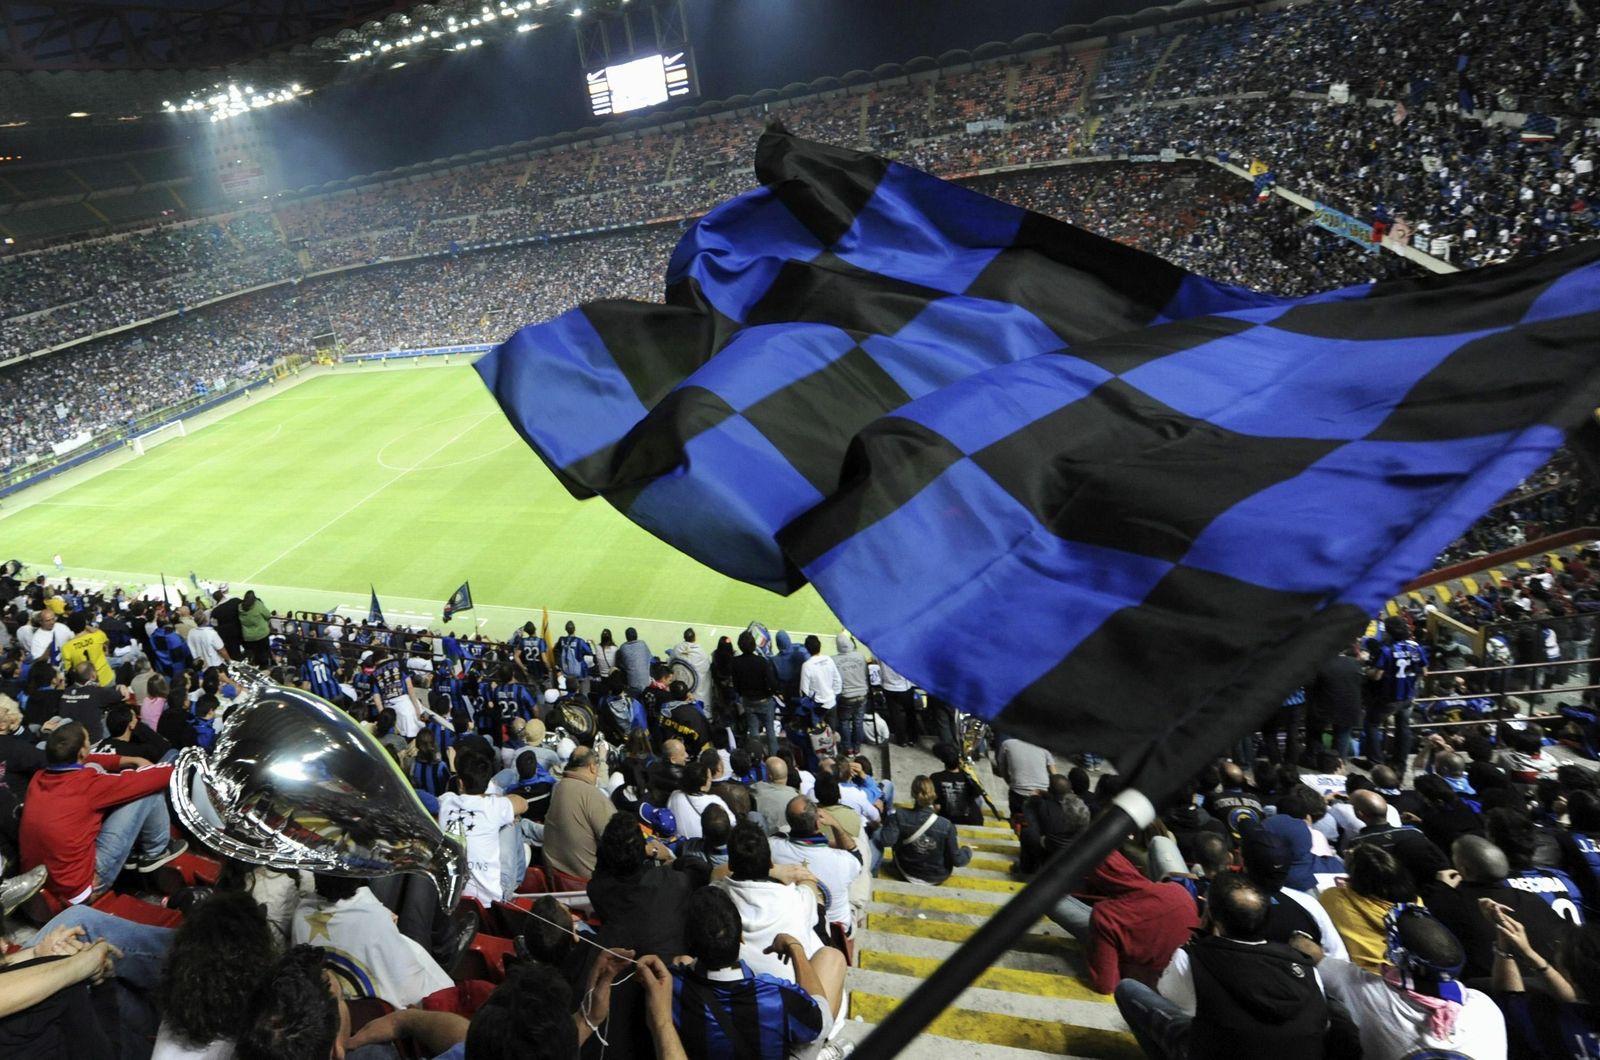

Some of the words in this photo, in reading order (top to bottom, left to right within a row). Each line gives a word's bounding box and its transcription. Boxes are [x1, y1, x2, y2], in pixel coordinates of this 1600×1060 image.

[73, 638, 94, 650] TOLDO
[83, 649, 90, 661] 1
[524, 646, 540, 661] 22
[313, 663, 328, 684] 11
[1507, 876, 1568, 893] RECOBA
